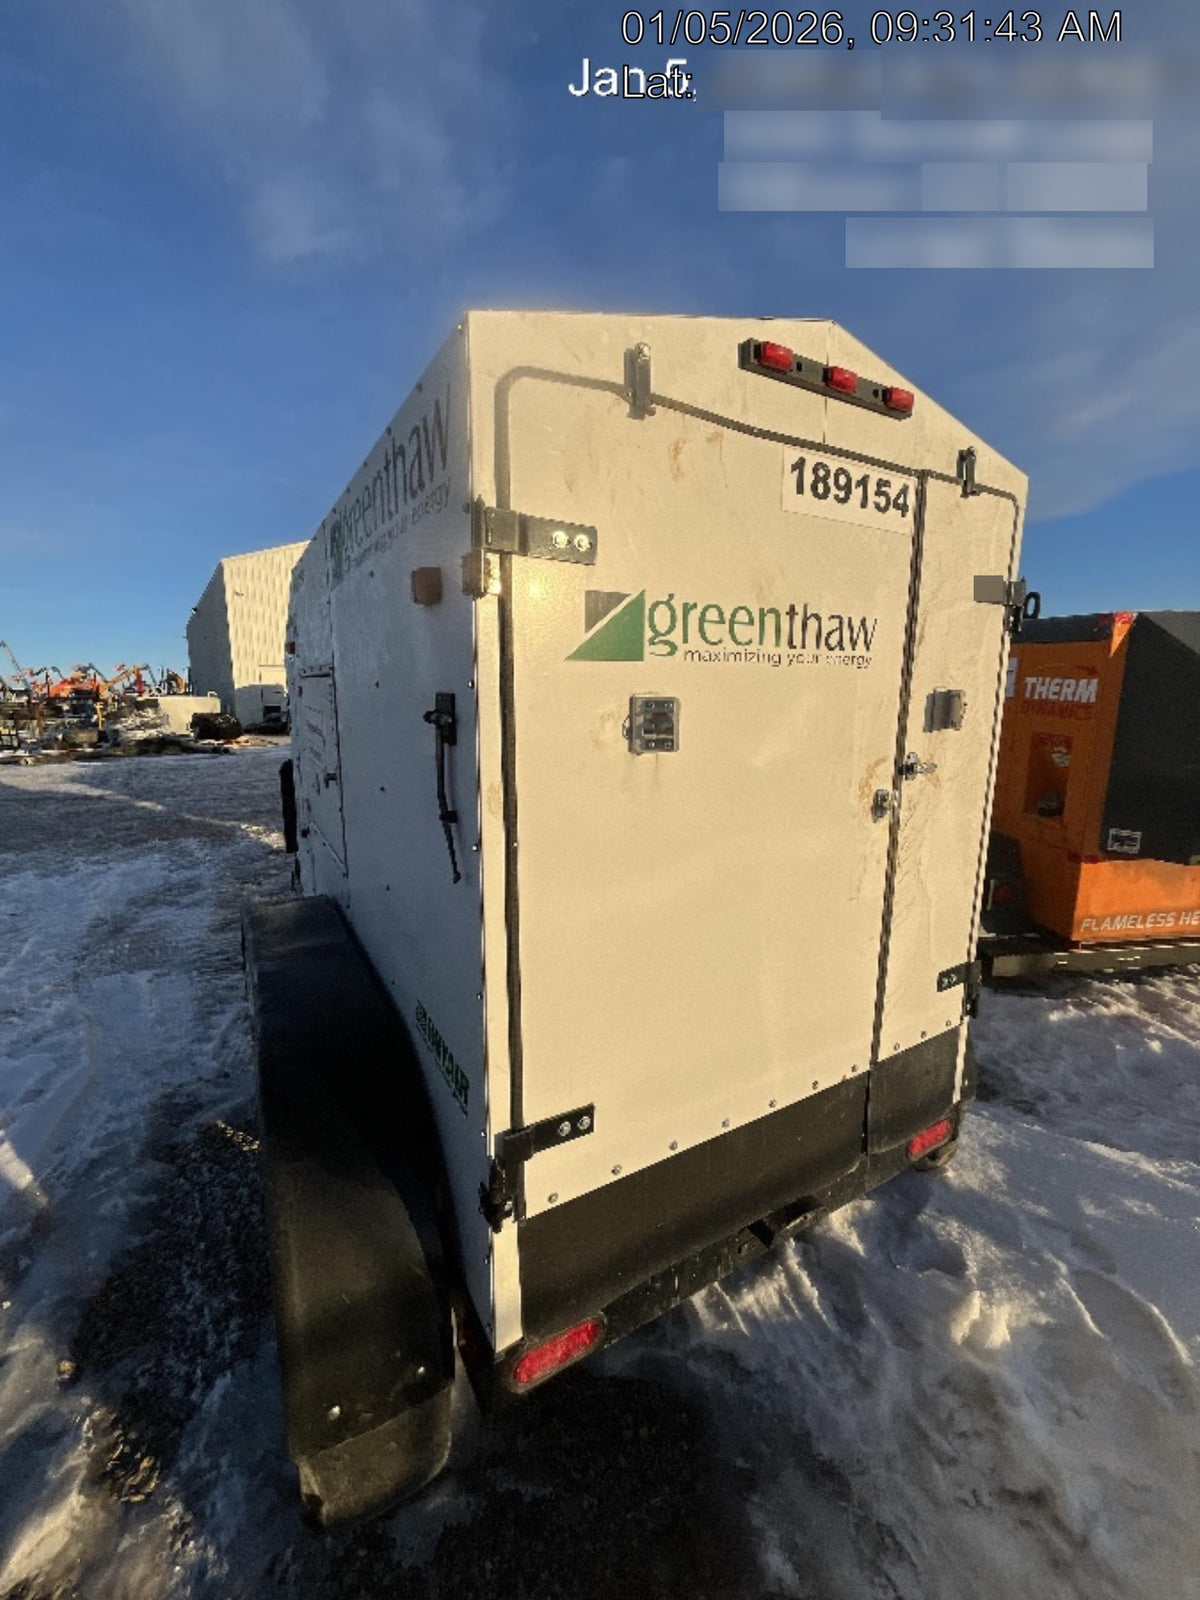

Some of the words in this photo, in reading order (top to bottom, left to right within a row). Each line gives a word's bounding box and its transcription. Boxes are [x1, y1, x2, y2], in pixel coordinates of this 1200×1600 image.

[790, 456, 909, 518] 189154
[647, 593, 878, 657] greenthaw
[683, 646, 782, 668] maximizing
[786, 653, 822, 667] your
[826, 654, 873, 669] energy
[1024, 676, 1099, 703] THERM
[1080, 911, 1177, 932] FLAMELESS
